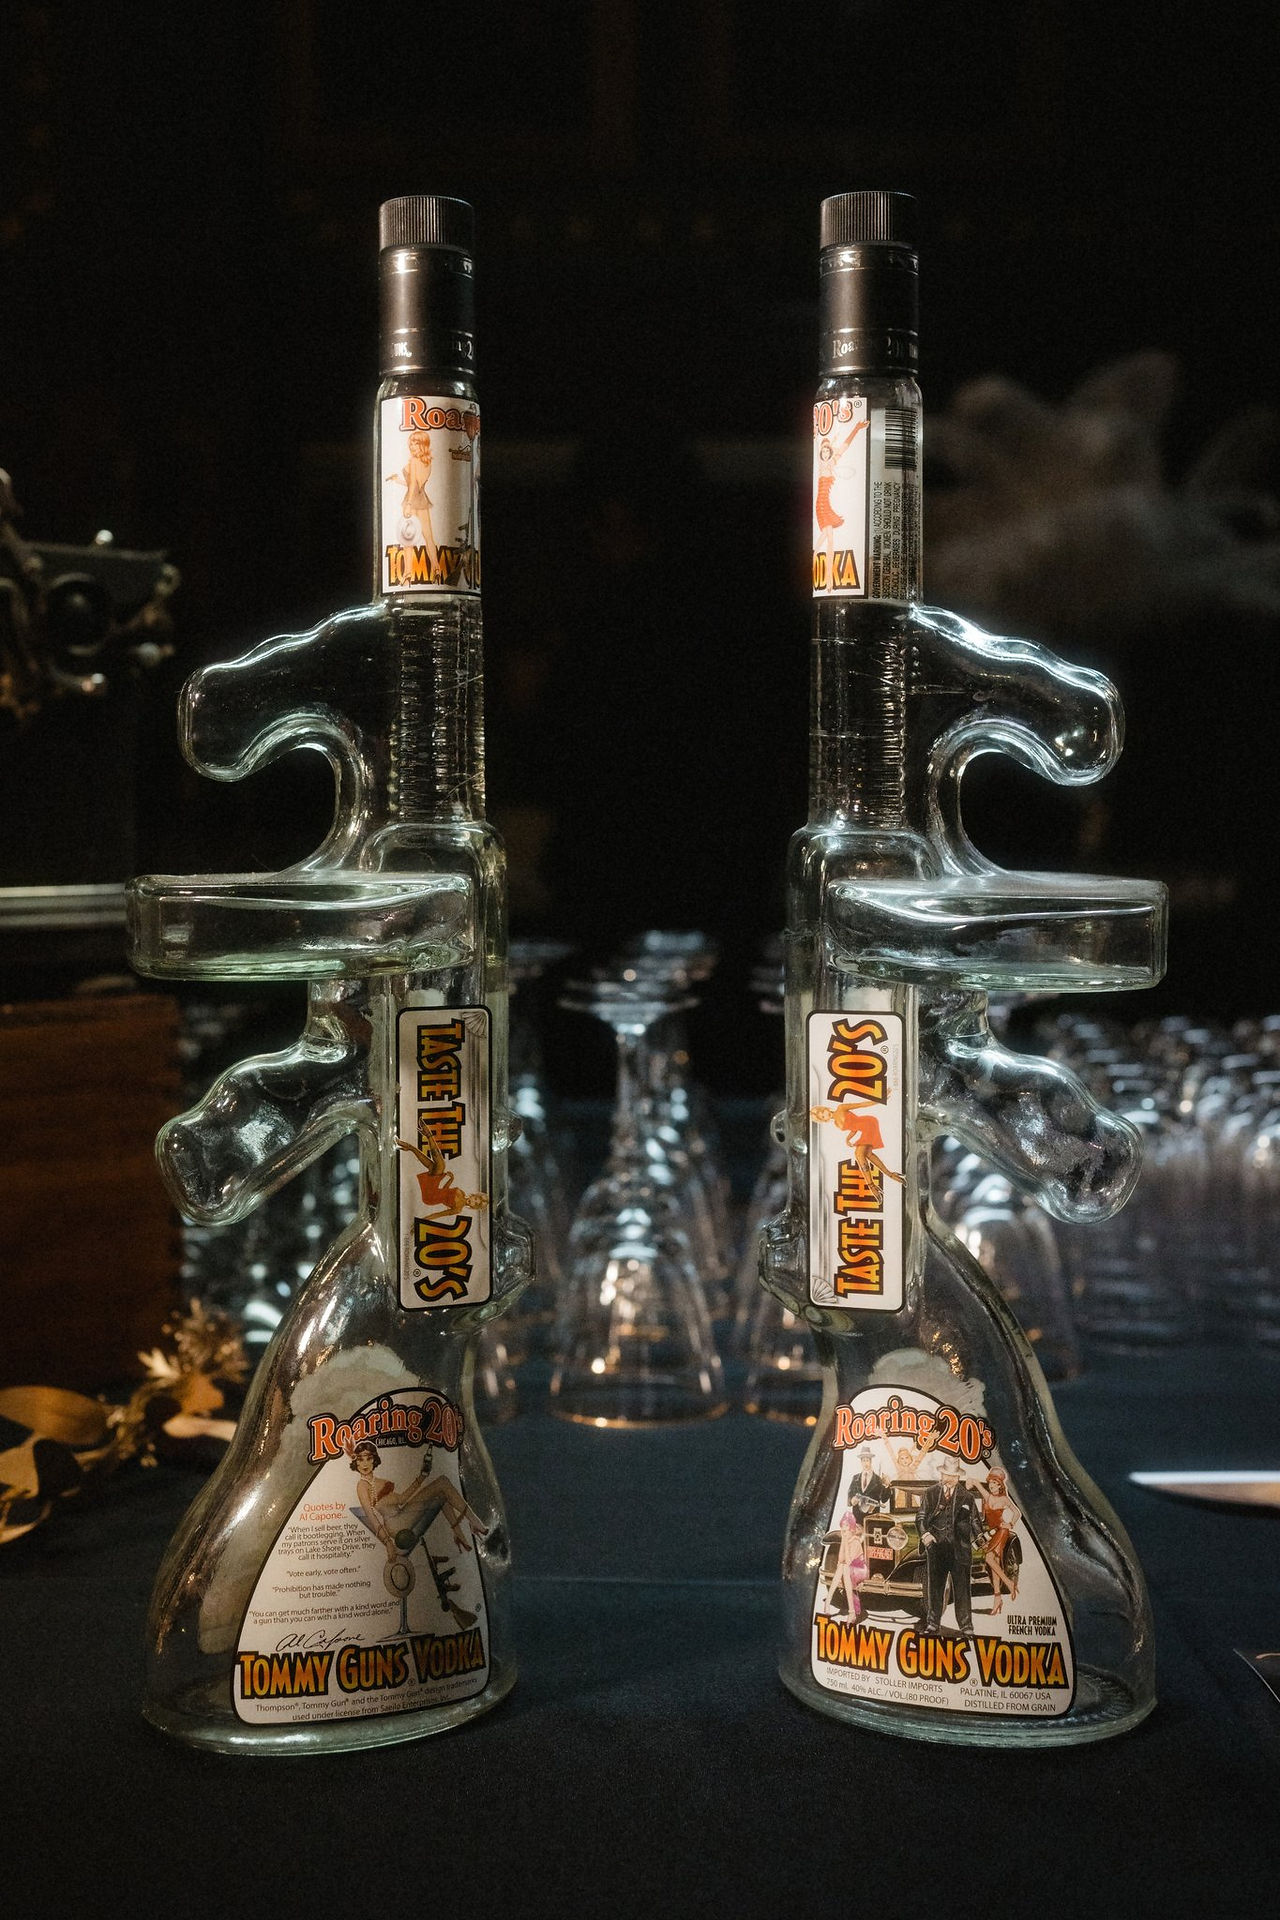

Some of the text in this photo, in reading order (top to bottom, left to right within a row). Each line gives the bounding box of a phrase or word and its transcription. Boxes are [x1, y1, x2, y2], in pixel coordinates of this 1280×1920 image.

[814, 399, 853, 437] 0's
[419, 1020, 464, 1100] TASTE
[419, 1103, 464, 1159] THE
[835, 1160, 882, 1215] THE
[835, 1219, 882, 1297] TASTE
[309, 1397, 424, 1462] Roaring
[833, 1398, 994, 1461] Roaring 20's
[304, 1502, 346, 1512] Quotes by
[344, 1523, 358, 1531] they
[362, 1542, 376, 1550] they
[345, 1580, 371, 1588] nothing
[291, 1608, 310, 1616] much
[311, 1607, 333, 1615] farther
[335, 1605, 349, 1613] with
[355, 1603, 369, 1611] kind
[274, 1616, 288, 1624] than
[338, 1611, 352, 1619] kind
[1007, 1615, 1057, 1626] ULTRA PREMIUM
[1008, 1626, 1056, 1636] FRENCH VODKA
[816, 1615, 1066, 1686] TOMMY GUNS VODKA
[239, 1630, 484, 1697] TOMMY GUNS VODKA
[827, 1667, 943, 1693] IMPORTED BY STOLLER IMPORTS
[302, 1701, 329, 1709] Tommy
[380, 1693, 405, 1702] Tommy
[961, 1688, 999, 1698] PALATINE,
[1036, 1692, 1051, 1700] USA
[362, 1705, 378, 1714] from
[965, 1700, 1056, 1712] DISTILLED FROM GRAIN
